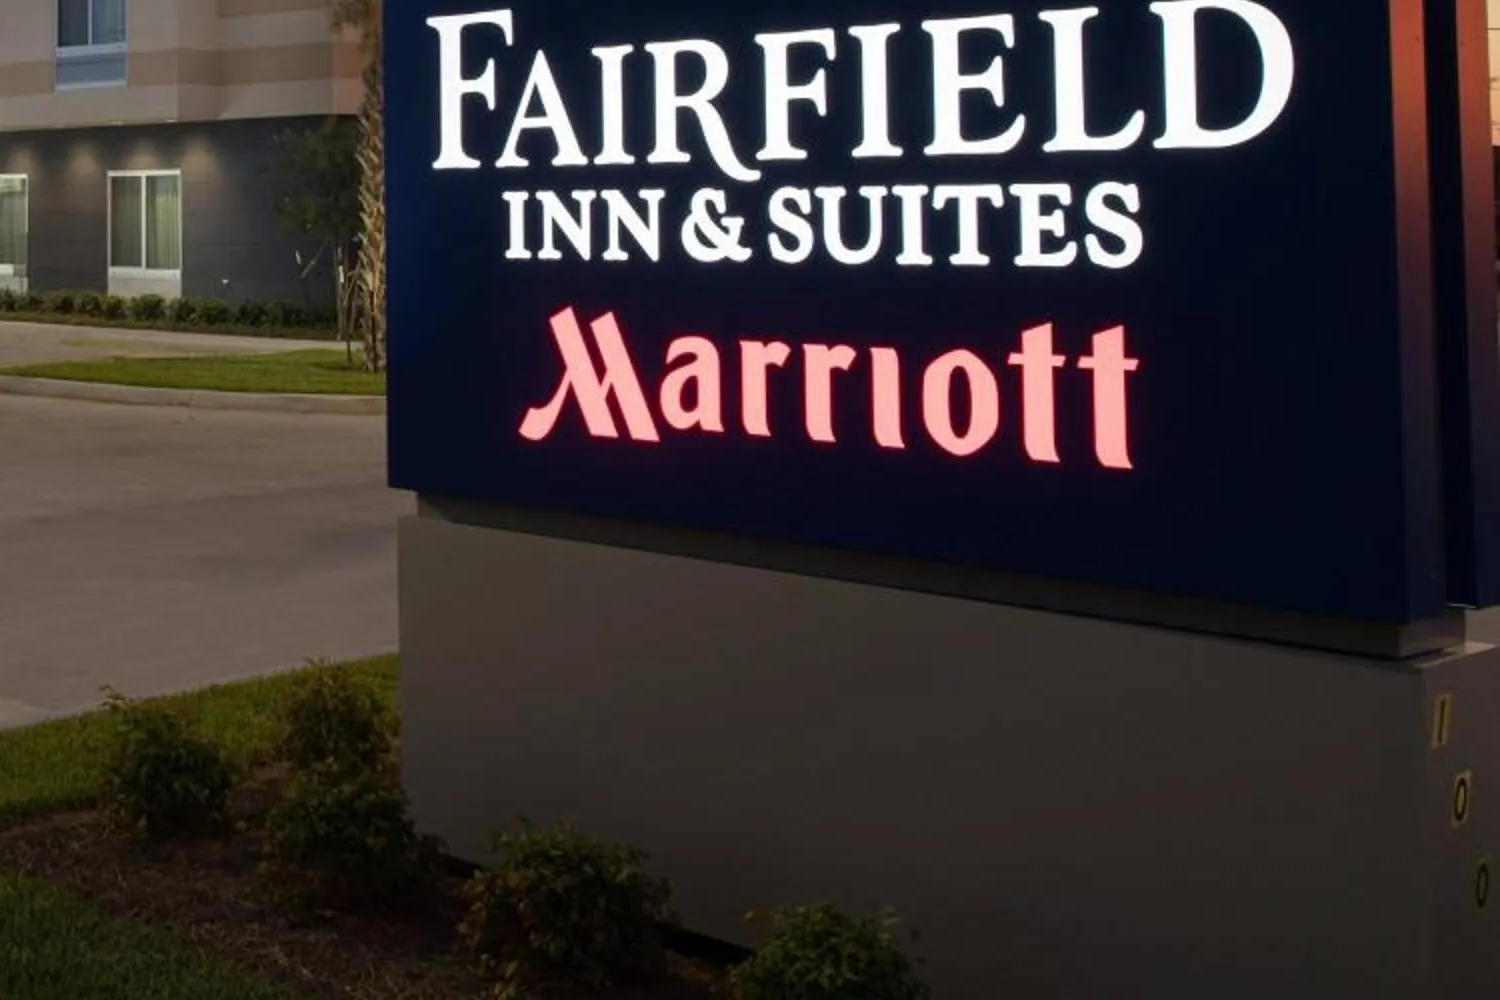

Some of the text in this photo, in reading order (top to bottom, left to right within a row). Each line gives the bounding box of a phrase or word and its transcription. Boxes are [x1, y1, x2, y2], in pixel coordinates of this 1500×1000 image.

[501, 181, 1144, 269] INN & SUITES
[518, 306, 1139, 469] Marriott
